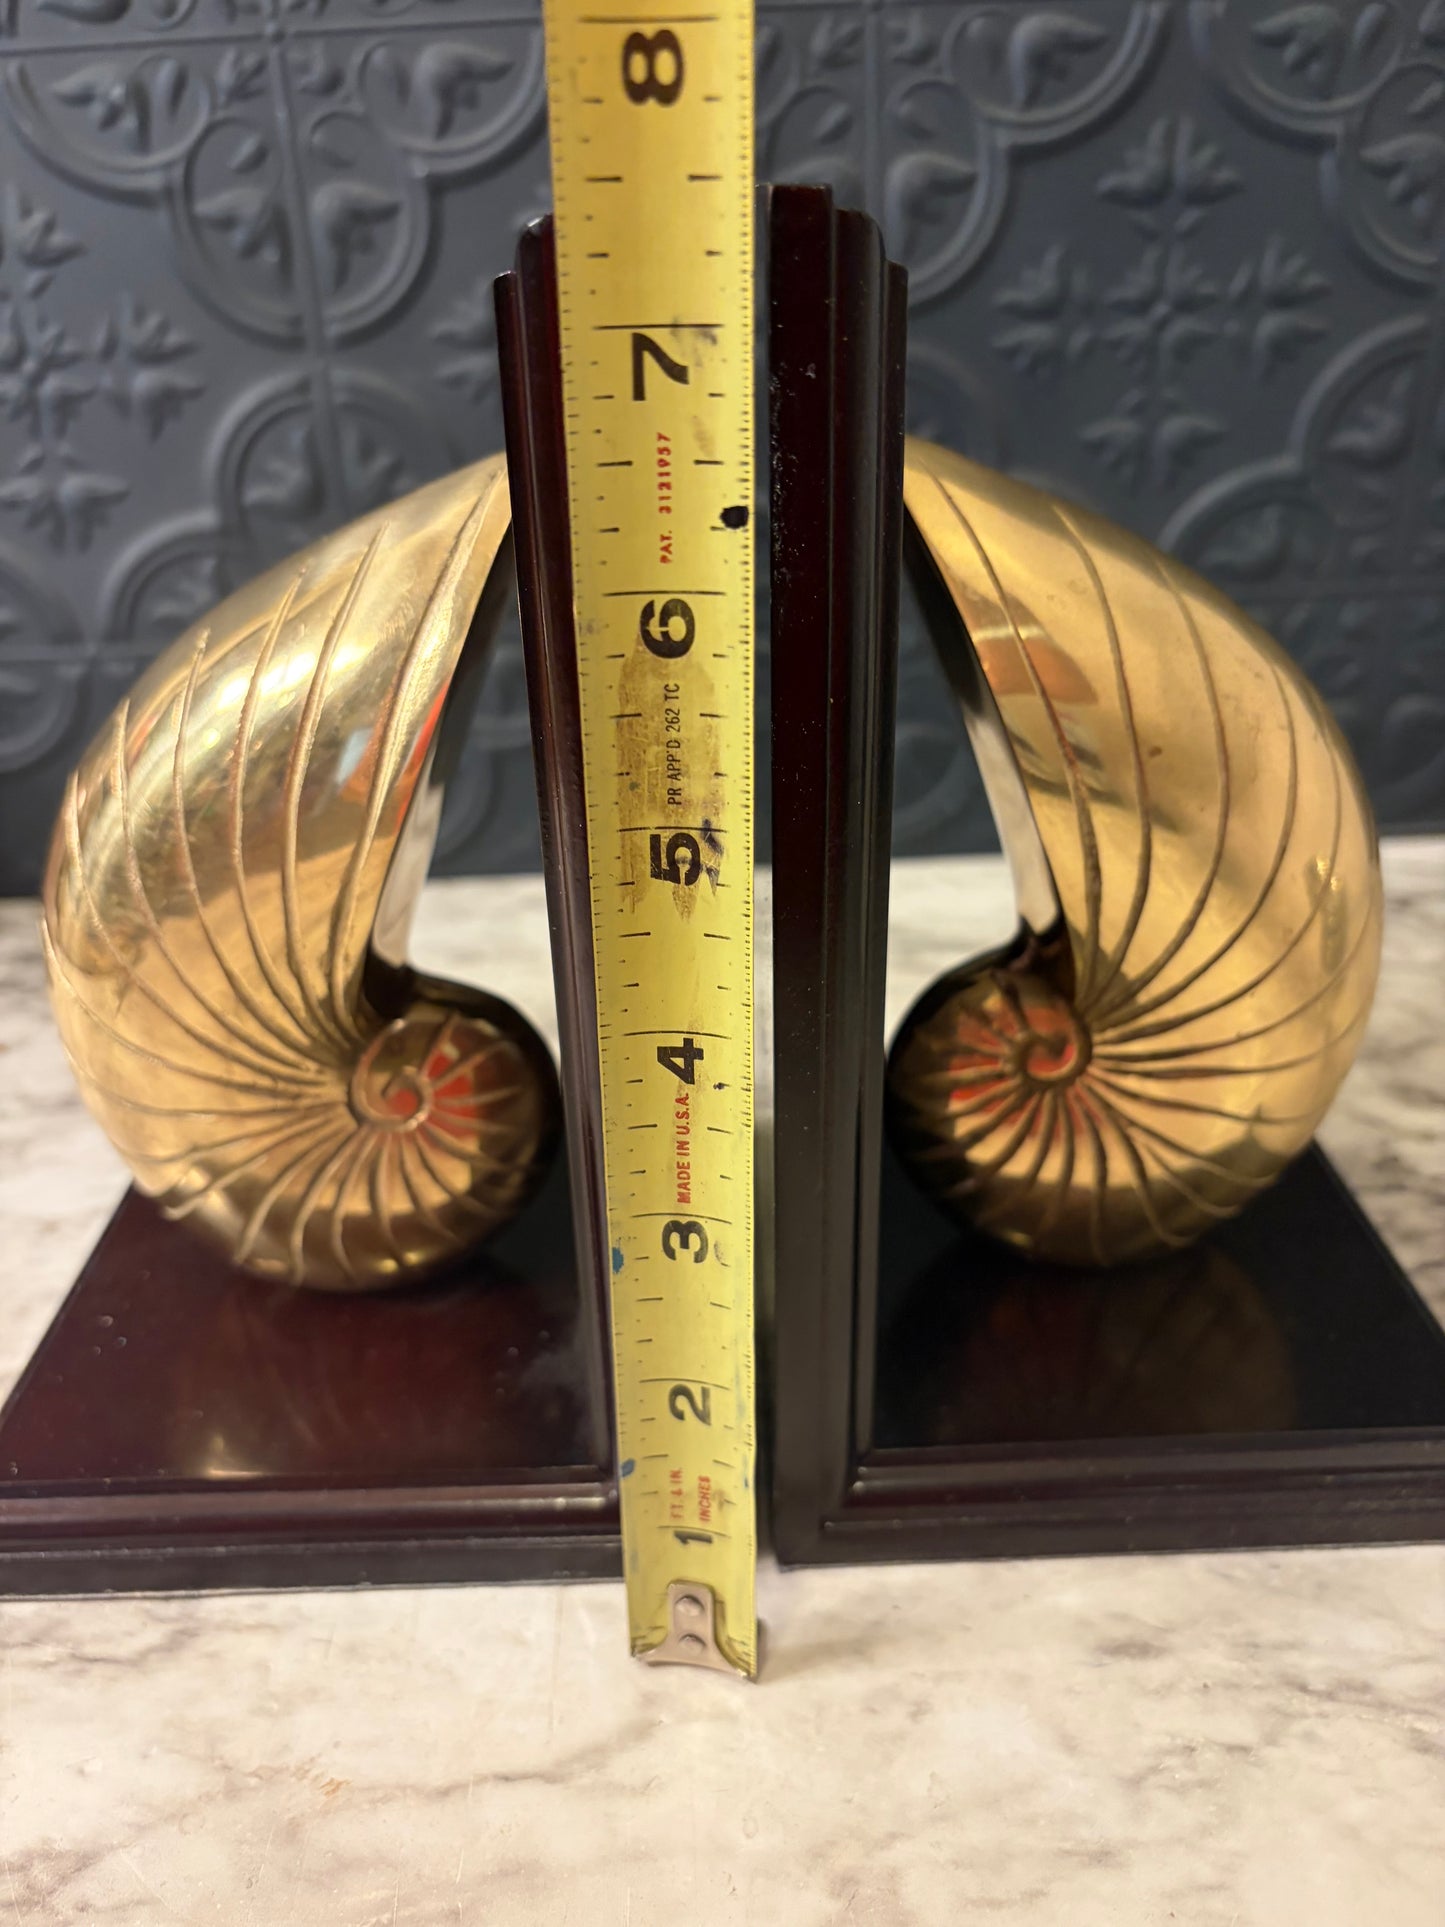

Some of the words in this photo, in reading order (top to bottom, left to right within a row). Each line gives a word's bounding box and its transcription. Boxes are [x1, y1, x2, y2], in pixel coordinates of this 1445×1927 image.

[622, 29, 686, 107] 8
[631, 332, 689, 401] 7
[657, 432, 672, 514] 3121957
[659, 530, 673, 564] PAT.
[640, 598, 695, 659] 6
[664, 683, 680, 701] TC
[666, 708, 681, 733] 262
[666, 739, 681, 780] APP'D
[667, 787, 682, 806] PR
[650, 832, 701, 886] 5
[657, 1038, 704, 1085] 4
[675, 1093, 690, 1135] U.S.A.
[676, 1141, 690, 1156] IN
[677, 1161, 691, 1204] MADE
[662, 1220, 708, 1264] 3
[668, 1384, 712, 1426] 2
[698, 1475, 711, 1523] INCHES
[673, 1529, 713, 1545] 1
